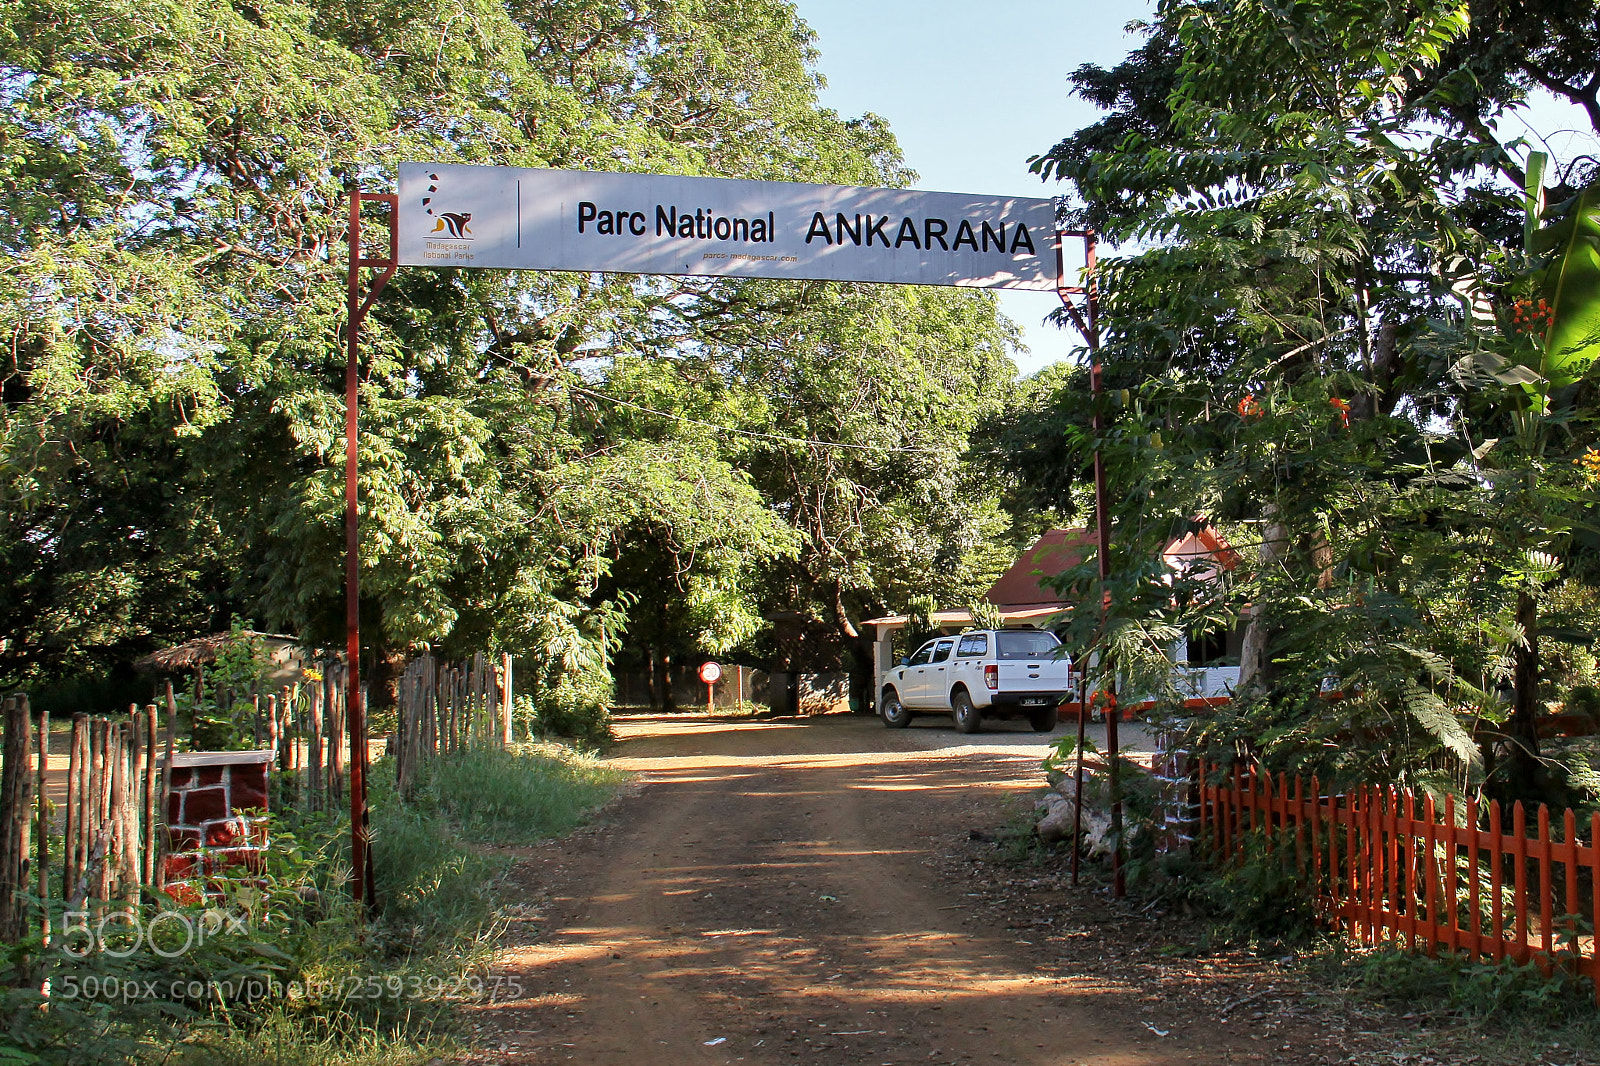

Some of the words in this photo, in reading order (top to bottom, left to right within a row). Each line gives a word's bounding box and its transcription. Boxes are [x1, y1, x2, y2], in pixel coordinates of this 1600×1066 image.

[578, 201, 646, 236] Parc
[655, 204, 774, 243] National
[805, 211, 1035, 255] ANKARANA
[426, 241, 472, 251] Madagascar
[423, 251, 451, 259] National
[454, 252, 474, 261] Parks
